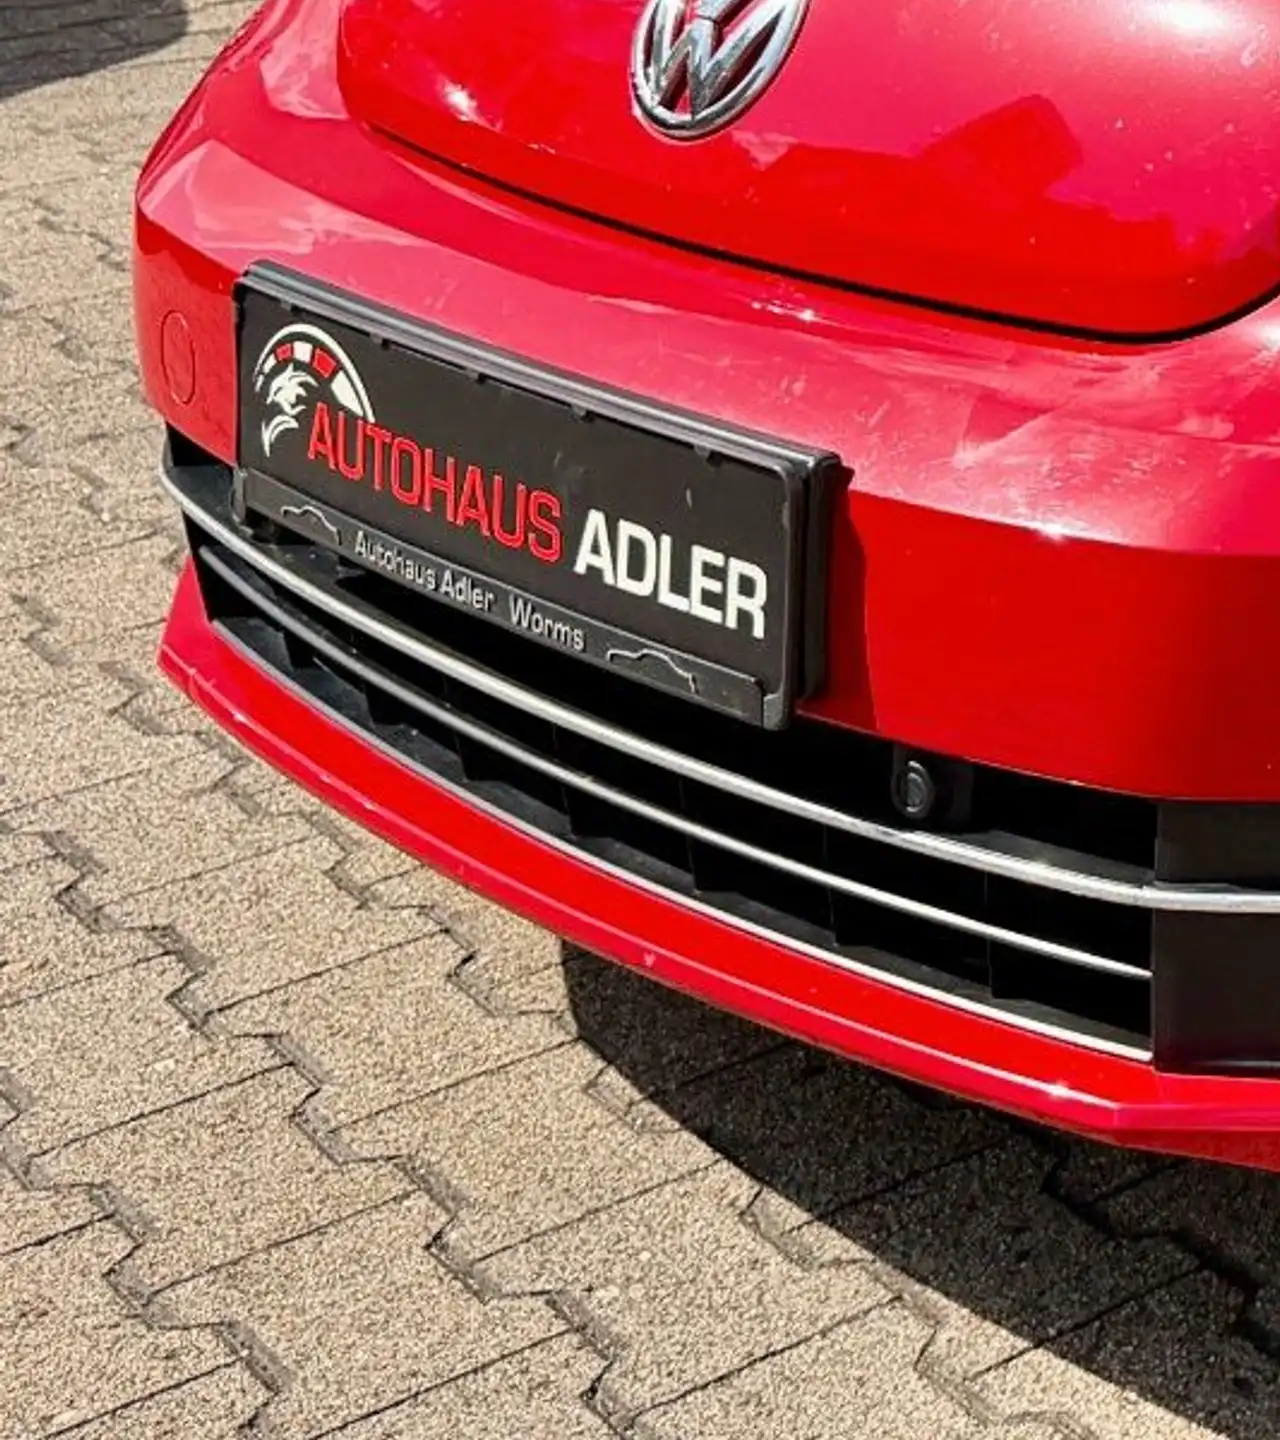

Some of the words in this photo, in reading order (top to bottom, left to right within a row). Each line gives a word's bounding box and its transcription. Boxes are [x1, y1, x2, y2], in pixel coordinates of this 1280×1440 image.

[307, 402, 564, 563] AUTOHAUS
[575, 510, 767, 638] ADLER
[353, 530, 437, 591] Autohaus
[440, 573, 496, 614] Adler
[509, 595, 586, 651] Worms
